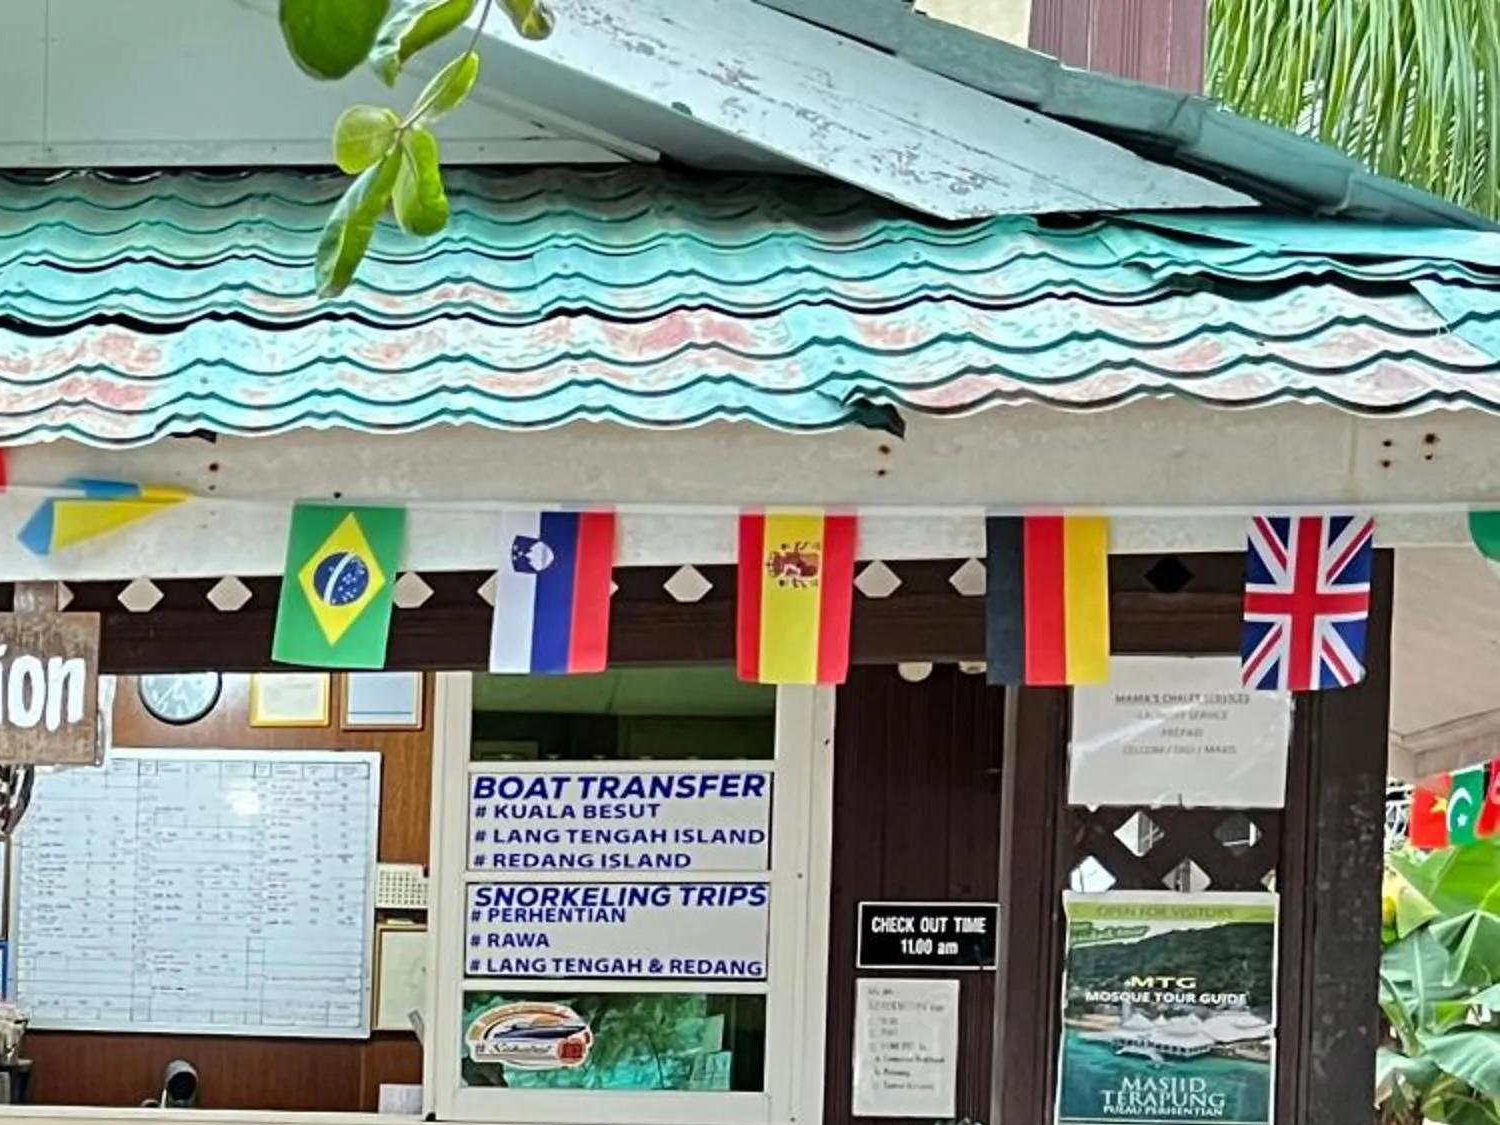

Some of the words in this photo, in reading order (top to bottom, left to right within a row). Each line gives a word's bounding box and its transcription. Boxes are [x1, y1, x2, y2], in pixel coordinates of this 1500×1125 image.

[473, 776, 571, 800] BOAT
[578, 774, 767, 800] TRANSFER
[494, 804, 576, 819] KUALA
[583, 803, 661, 819] BESUT
[493, 829, 561, 844] LANG
[566, 829, 667, 844] TENGAH
[674, 829, 766, 844] ISLAND
[493, 853, 594, 868] REDANG
[601, 854, 691, 868] ISLAND
[474, 887, 672, 907] SNORKELING
[680, 886, 767, 908] TRIPS
[487, 908, 627, 923] PERHENTIAN
[871, 916, 915, 933] CHECK
[920, 916, 949, 933] OUT
[953, 916, 987, 933] TIME
[487, 933, 550, 948] RAWA
[900, 938, 933, 955] 11.00
[937, 942, 959, 955] am
[487, 958, 547, 973] LANG
[552, 958, 642, 974] TENGAH
[650, 959, 664, 974] &
[670, 959, 763, 976] REDANG
[1131, 976, 1197, 989] MTG
[1085, 991, 1150, 1004] MOSQUE
[1154, 992, 1195, 1004] TOUR
[1199, 992, 1248, 1005] GUIDE
[1121, 1076, 1207, 1093] MASJID
[1101, 1090, 1225, 1108] TERAPUNG
